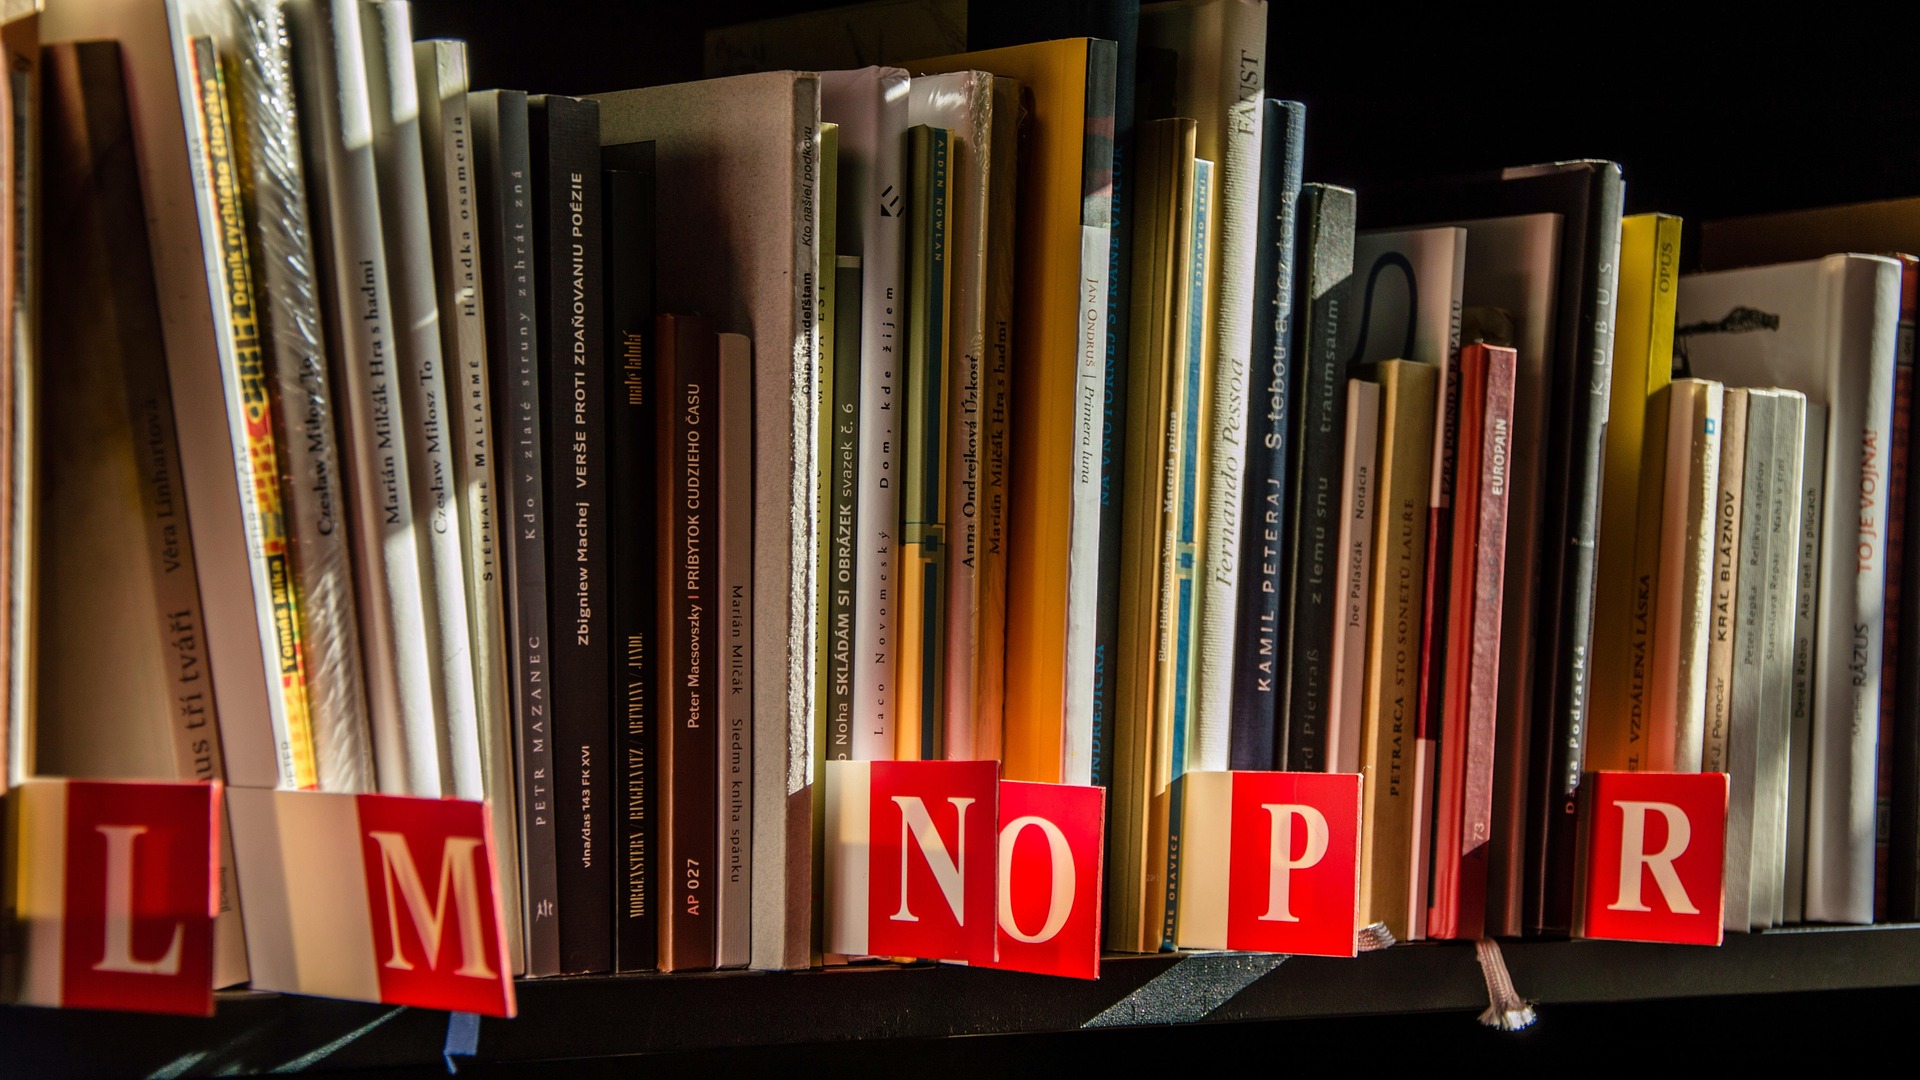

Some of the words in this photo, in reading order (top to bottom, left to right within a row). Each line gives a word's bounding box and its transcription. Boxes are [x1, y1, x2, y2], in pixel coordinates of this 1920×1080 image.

[1238, 50, 1259, 136] FAUST
[452, 117, 469, 220] osamenia
[804, 126, 814, 181] podkovu
[937, 139, 945, 188] ALDEN
[511, 170, 523, 207] zná
[569, 173, 583, 237] POÉZIE
[802, 183, 812, 225] našiel
[802, 227, 812, 247] Kto
[934, 197, 943, 261] NOWLAN
[514, 224, 527, 296] zahrát
[1659, 242, 1673, 293] OPUS
[359, 260, 378, 321] hadmi
[570, 244, 586, 365] ZDAŇOVANIU
[882, 287, 895, 353] žijem
[369, 338, 384, 379] Hra
[519, 313, 530, 386] struny
[993, 321, 1007, 370] hadmi
[1085, 308, 1098, 367] ONDRUŠ
[1590, 262, 1611, 396] KUBUS
[420, 361, 433, 386] To
[880, 371, 891, 410] kde
[1268, 347, 1286, 421] tebou
[1320, 300, 1338, 433] traumsaum
[372, 385, 391, 449] Milčák
[423, 391, 440, 453] Miłosz
[469, 361, 485, 467] MALLARMÉ
[574, 371, 586, 425] PROTI
[684, 383, 700, 425] ČASU
[841, 403, 853, 414] 6
[992, 391, 1004, 425] Hra
[1082, 386, 1095, 446] Primera
[1222, 359, 1243, 447] Pessoa
[1445, 392, 1457, 450] POUND
[521, 402, 532, 459] zlaté
[840, 421, 853, 435] č.
[1265, 433, 1282, 450] S
[1491, 419, 1507, 496] EUROPAIN
[572, 431, 587, 489] VERŠE
[687, 431, 700, 510] CUDZIEHO
[840, 442, 853, 499] svazek
[880, 429, 892, 488] Dom,
[959, 421, 979, 518] Ondrejková
[990, 429, 1003, 487] Milčák
[1081, 451, 1093, 484] luna
[1442, 454, 1453, 496] EZRA
[1860, 429, 1880, 510] VOJNA!
[313, 460, 334, 536] Czesław
[383, 455, 400, 524] Marián
[429, 460, 447, 534] Czesław
[523, 498, 536, 539] Kdo
[1317, 477, 1328, 518] snu
[1354, 466, 1367, 519] Notácia
[161, 525, 181, 573] Věra
[575, 502, 590, 562] Machej
[836, 504, 852, 583] OBRÁZEK
[962, 523, 975, 568] Anna
[988, 495, 1001, 554] Marián
[1216, 457, 1239, 587] Fernando
[1262, 478, 1280, 592] PETERAJ
[1720, 491, 1735, 582] BLÁZNOV
[1859, 517, 1877, 543] JE
[685, 515, 700, 590] PRÍBYTOK
[1309, 526, 1325, 585] lemu
[1350, 541, 1363, 599] Palaščák
[1857, 546, 1873, 574] TO
[577, 567, 591, 645] Zbigniew
[731, 585, 743, 637] Marián
[838, 588, 850, 606] SI
[875, 531, 890, 664] Novomeský
[1312, 593, 1322, 605] z
[1349, 604, 1360, 627] Joe
[1636, 574, 1650, 636] LÁSKA
[168, 608, 199, 683] tváří
[276, 608, 297, 673] Tomáš
[628, 632, 644, 670] JANDL
[687, 604, 702, 687] Macsovszky
[731, 645, 743, 695] Milčák
[834, 614, 849, 696] SKLÁDÁM
[1257, 610, 1274, 692] KAMIL
[1395, 650, 1407, 686] STO
[1848, 623, 1869, 687] RÁZUS
[179, 693, 205, 730] tři
[528, 636, 545, 752] MAZANEC
[628, 681, 645, 736] ARTMANN
[687, 692, 700, 729] Peter
[835, 702, 848, 745] Noha
[874, 684, 885, 735] Laco
[1569, 645, 1585, 749] Podracká
[1711, 677, 1724, 739] Perecár
[581, 745, 590, 767] XVI
[732, 718, 743, 773] Siedma
[1390, 697, 1405, 797] PETRARCA
[534, 767, 547, 826] PETR
[581, 768, 590, 786] FK
[581, 788, 590, 811] 143
[628, 748, 645, 821] RINGELNATZ
[731, 780, 742, 822] kniha
[581, 813, 592, 869] vlna/das
[730, 829, 743, 883] spánku
[889, 795, 976, 927] N
[1473, 822, 1485, 841] 73
[1607, 800, 1700, 915] R
[628, 832, 645, 919] MORGENSTERN
[686, 858, 700, 890] 027
[999, 815, 1076, 943] O
[1168, 834, 1178, 901] ORAVECZ
[1257, 803, 1329, 922] P
[91, 824, 186, 976] L
[368, 829, 499, 980] M
[686, 894, 700, 916] AP
[1164, 908, 1175, 943] IMRE
